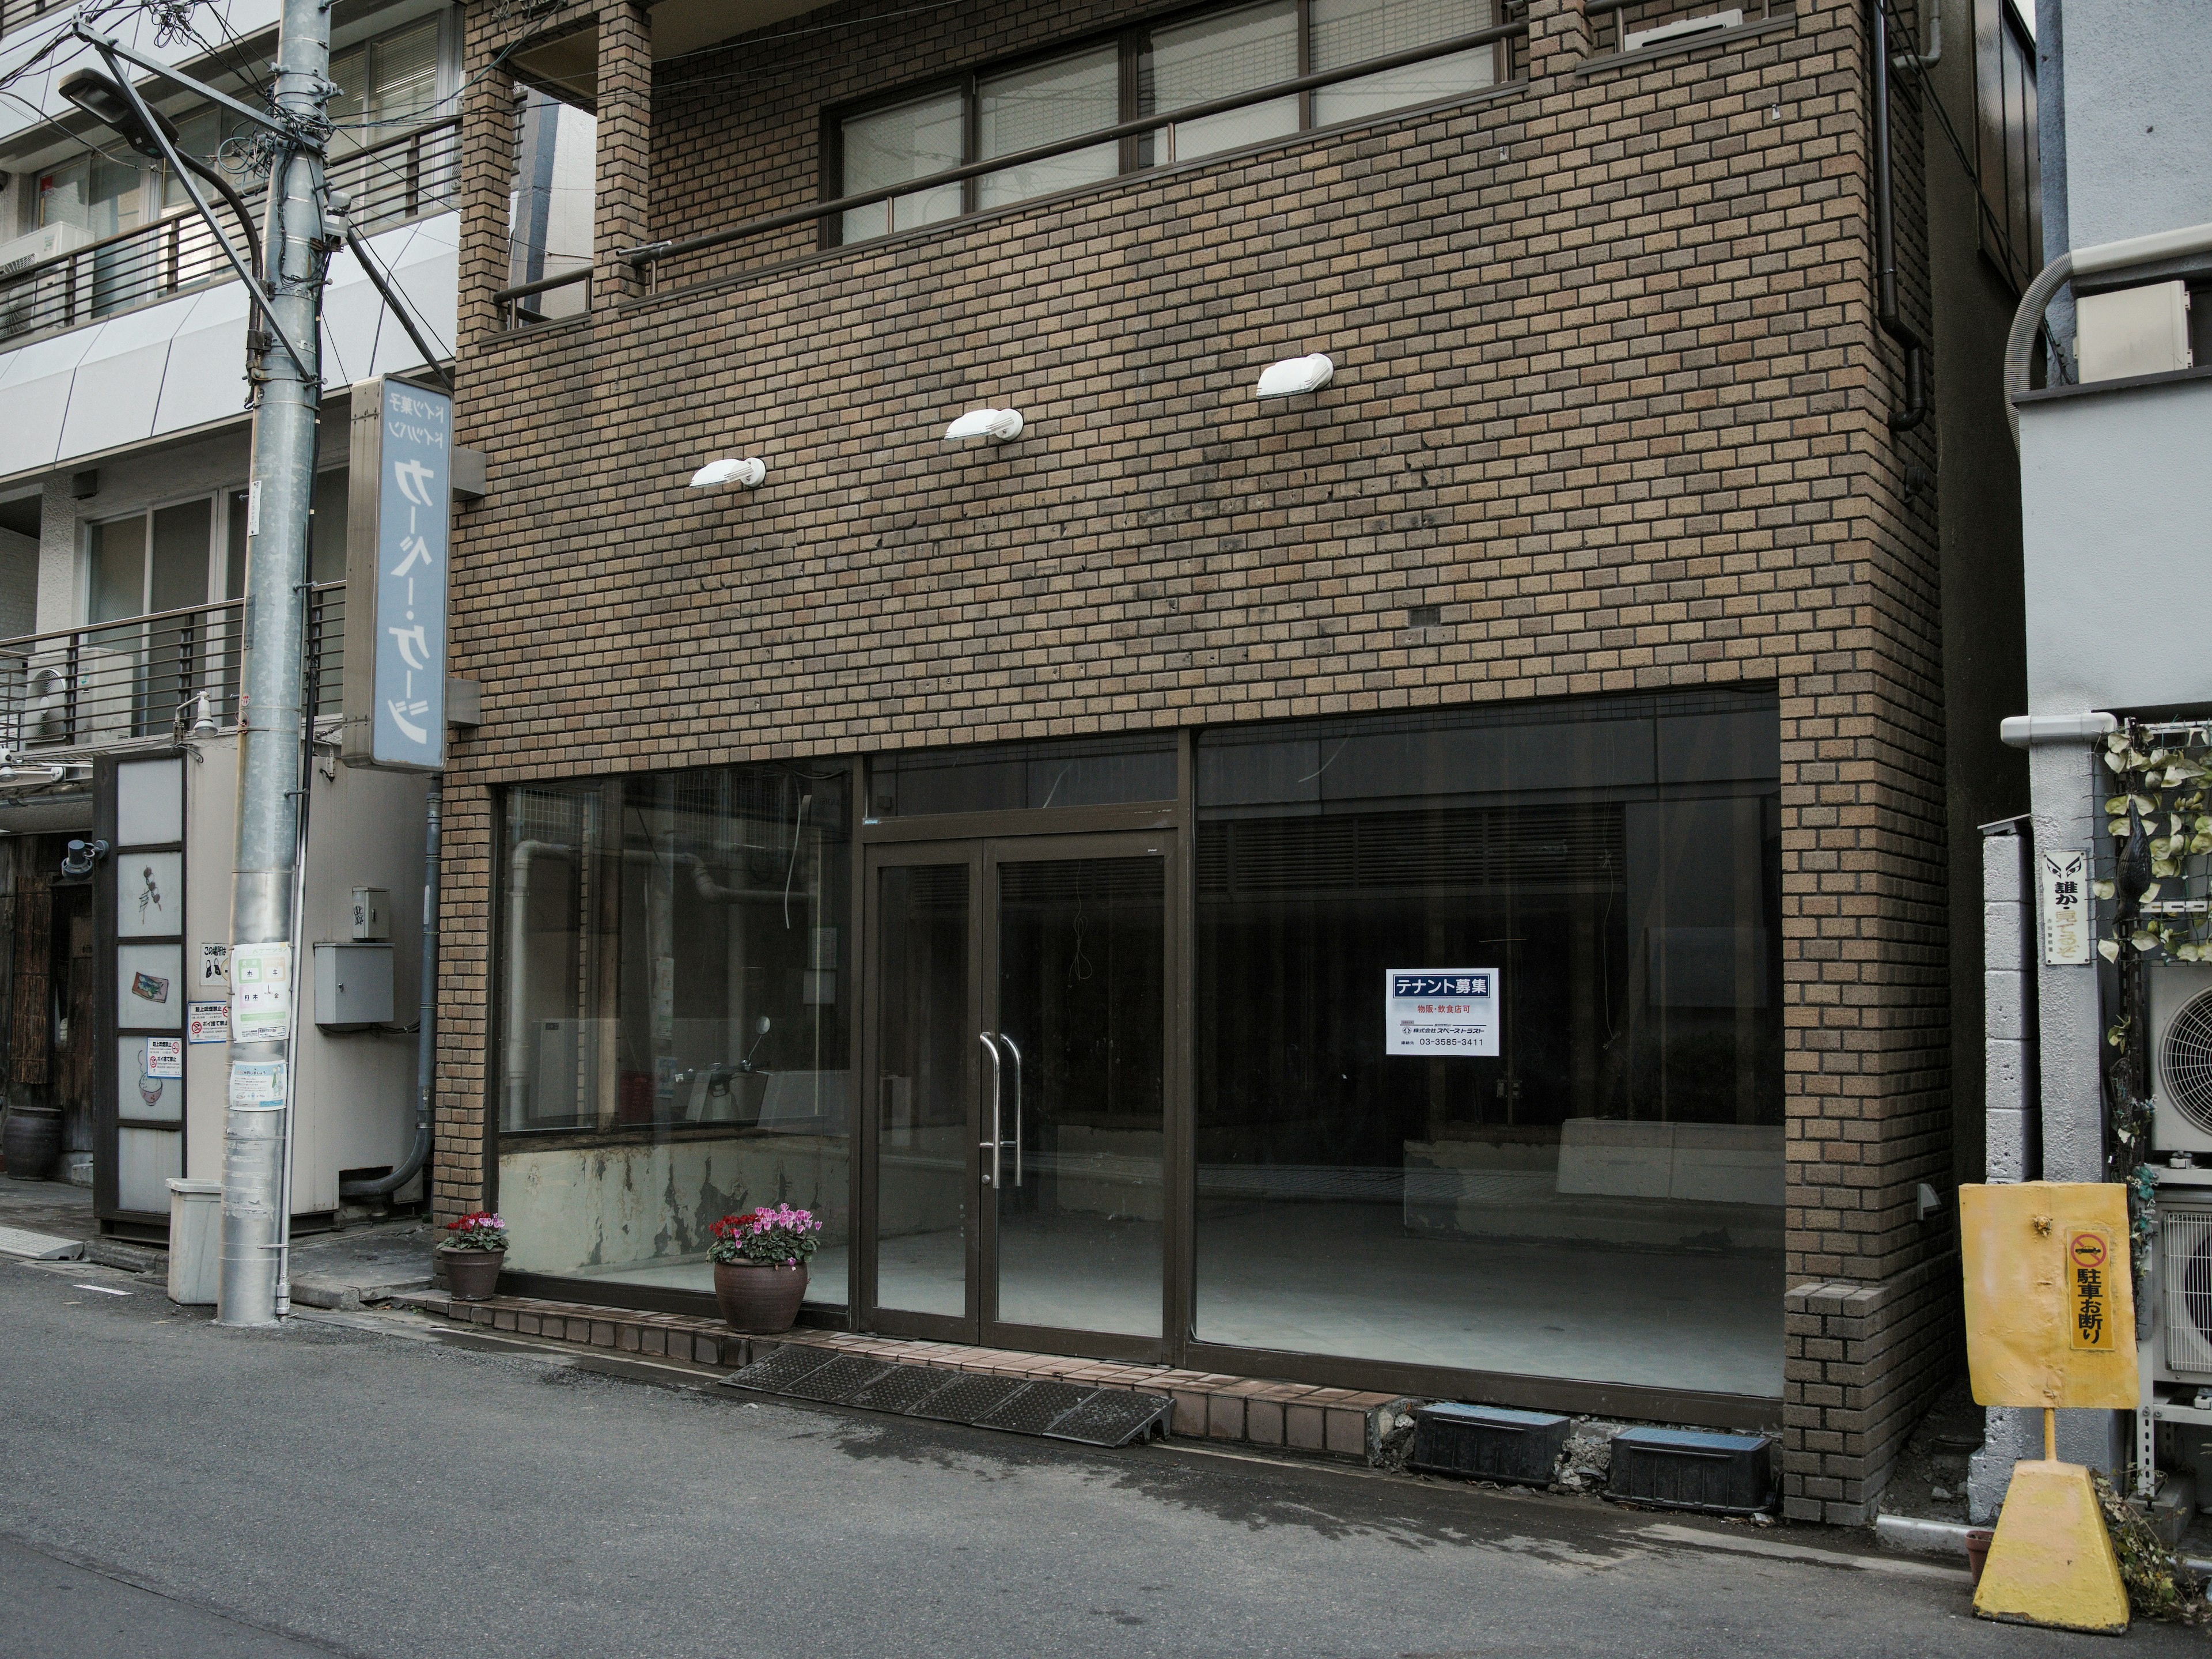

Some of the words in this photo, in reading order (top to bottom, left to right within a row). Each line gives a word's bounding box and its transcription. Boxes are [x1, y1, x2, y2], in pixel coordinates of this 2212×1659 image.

[204, 946, 226, 956] この場所は
[1397, 978, 1487, 994] テナント募集
[1417, 1005, 1471, 1014] 物販・飲食店可
[1419, 1038, 1483, 1046] 03-3585-3411
[2077, 1268, 2103, 1344] 駐車お断り
